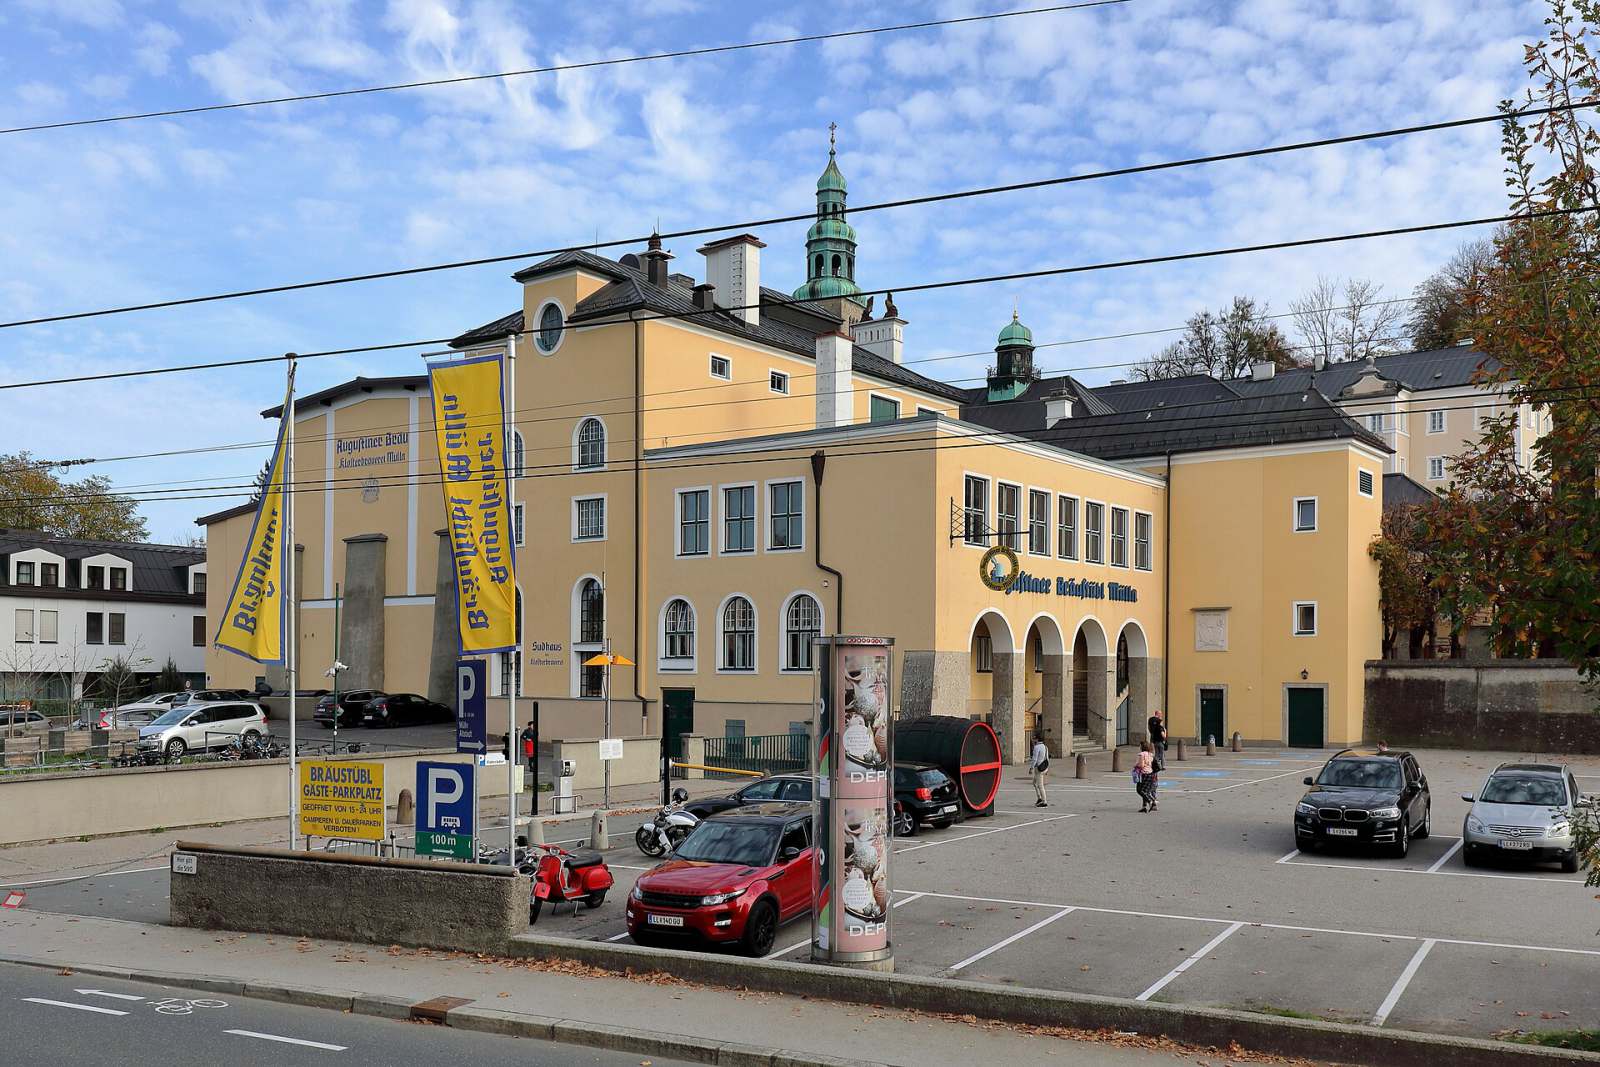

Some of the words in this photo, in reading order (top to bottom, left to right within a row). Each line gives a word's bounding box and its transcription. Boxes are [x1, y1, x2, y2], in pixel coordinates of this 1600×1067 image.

[531, 641, 562, 652] Sudhaus
[310, 765, 373, 785] BRÄUSTÜBL
[303, 784, 382, 800] GÄSTE-PARKPLATZ
[334, 805, 347, 813] VON
[369, 807, 382, 815] UHR
[303, 816, 333, 825] CAMPIEREN
